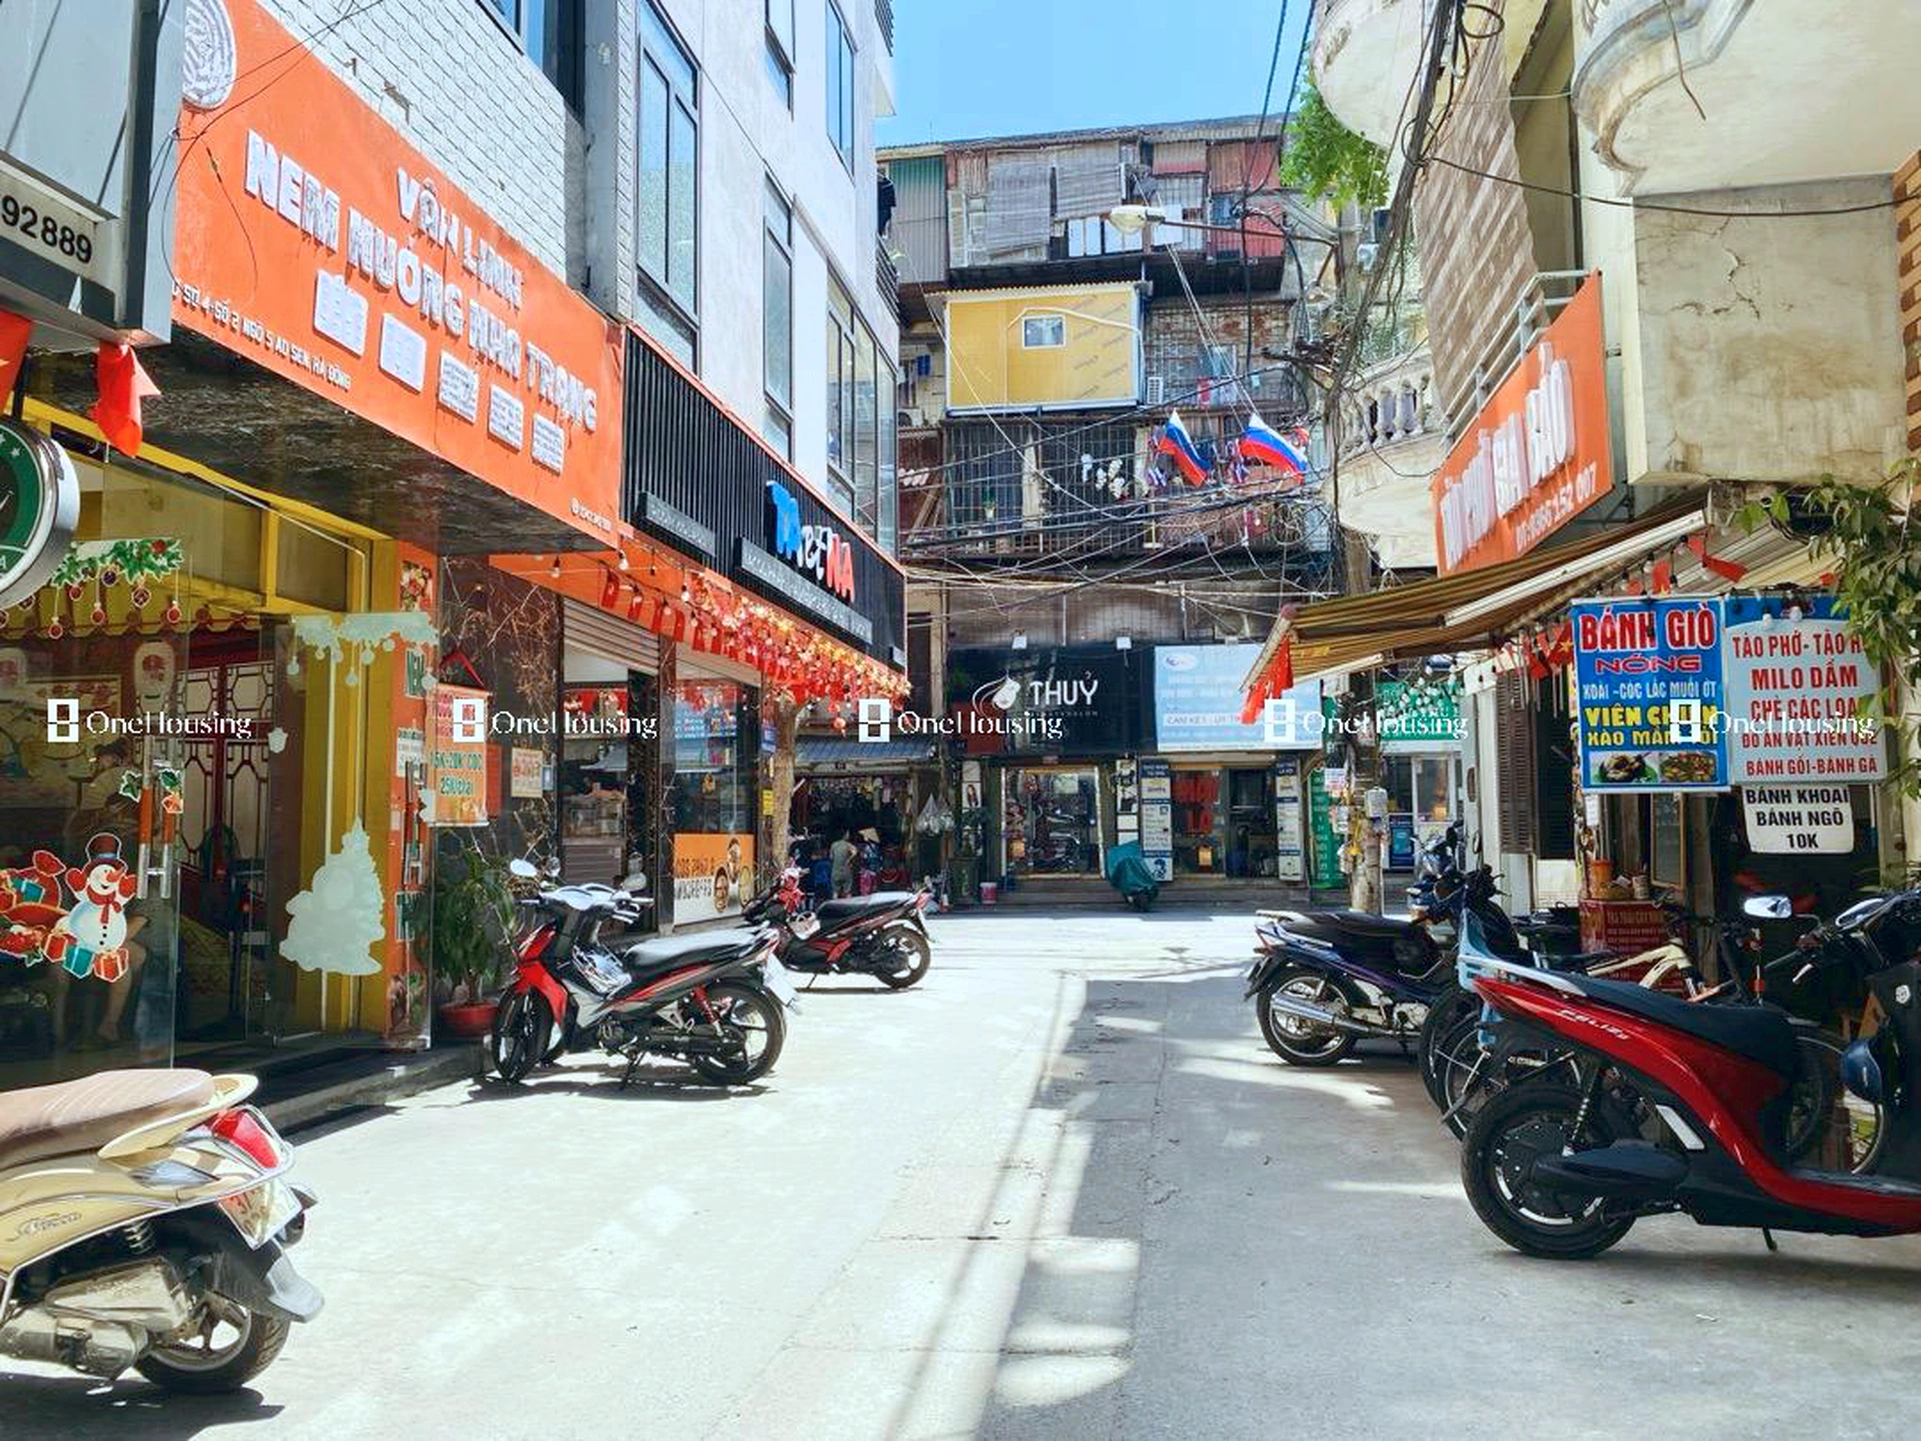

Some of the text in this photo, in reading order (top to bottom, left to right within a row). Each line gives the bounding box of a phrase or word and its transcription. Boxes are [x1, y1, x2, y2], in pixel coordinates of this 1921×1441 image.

[2, 195, 92, 264] 92889
[244, 128, 341, 252] NEM
[527, 341, 597, 432] TRANG
[1580, 603, 1717, 652] BÁNH GIÒ
[1732, 632, 1763, 659] TÀO
[1813, 629, 1845, 656] TÀO
[1595, 652, 1701, 675] NÓNG
[1752, 667, 1803, 691] MILO
[1585, 702, 1642, 727] VIÊN
[1751, 695, 1783, 722] CHÈ
[1788, 694, 1821, 720] CÁC
[1588, 727, 1625, 746] XÀO
[1746, 756, 1783, 776] BÁNH
[1858, 753, 1878, 774] GÀ
[1746, 786, 1850, 804] BÁNH KHOAI
[1756, 807, 1844, 826] BÁNH NGÔ
[1786, 833, 1819, 849] 10K
